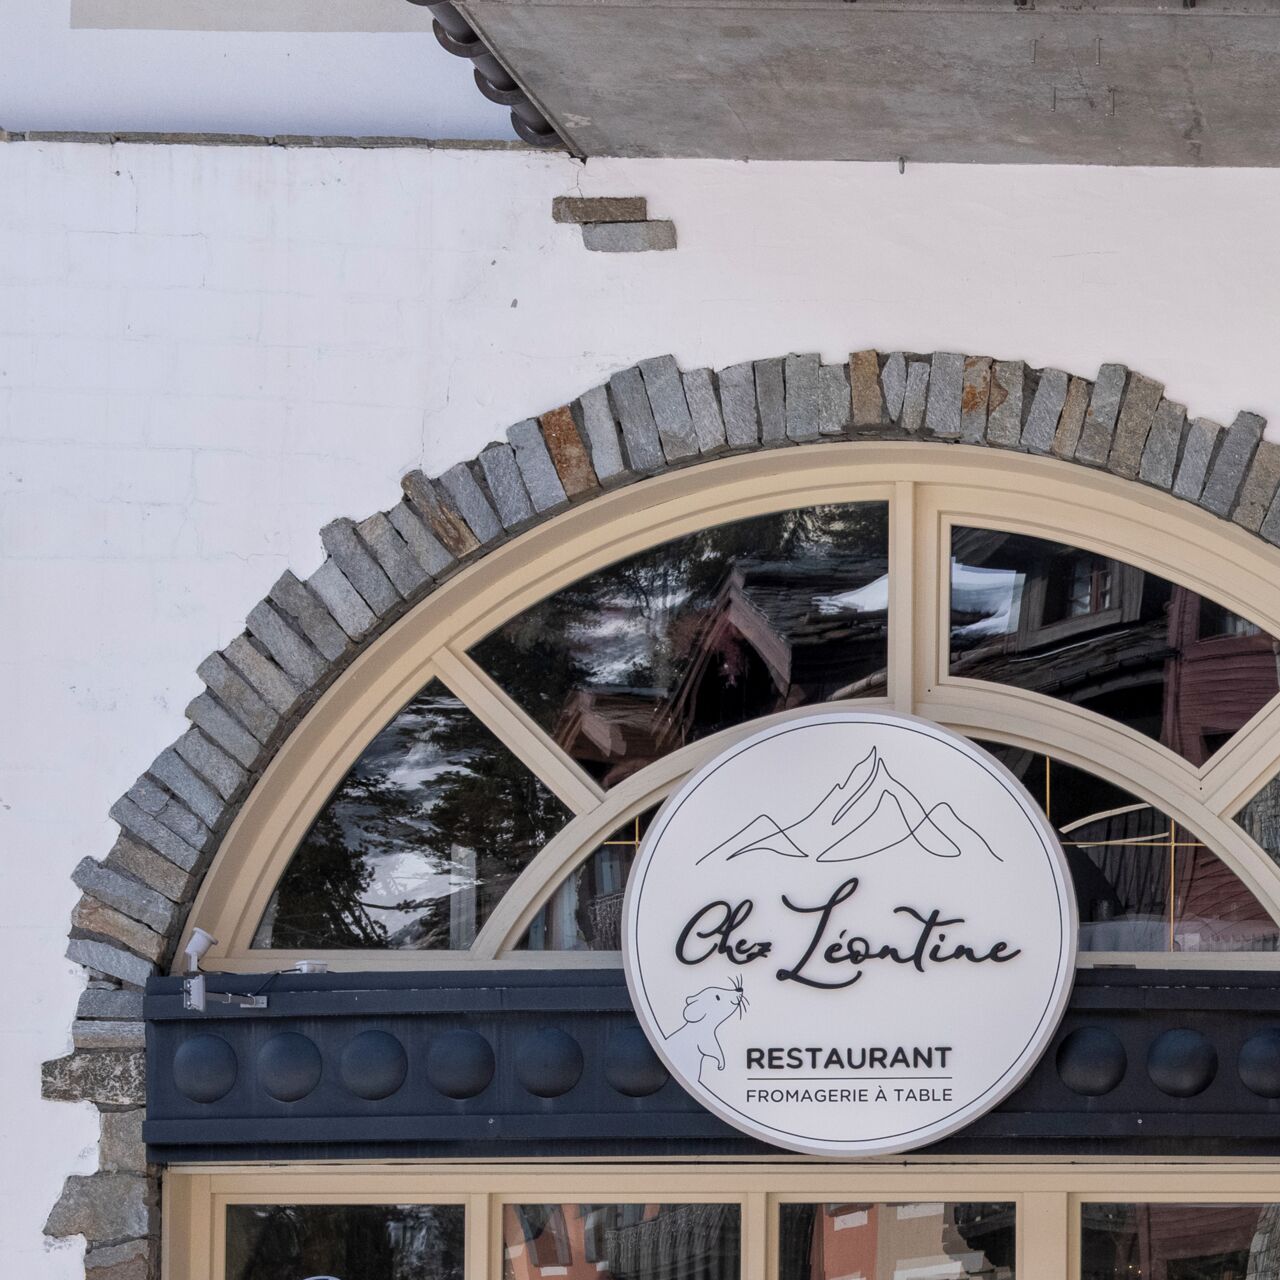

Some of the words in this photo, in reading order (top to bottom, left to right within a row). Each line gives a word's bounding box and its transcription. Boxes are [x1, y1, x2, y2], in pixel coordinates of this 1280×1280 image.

[675, 899, 772, 966] Chez
[776, 876, 1022, 990] Léontine
[745, 1046, 953, 1070] RESTAURANT
[745, 1088, 869, 1103] FROMAGERIE
[874, 1082, 888, 1103] À
[893, 1088, 953, 1102] TABLE
